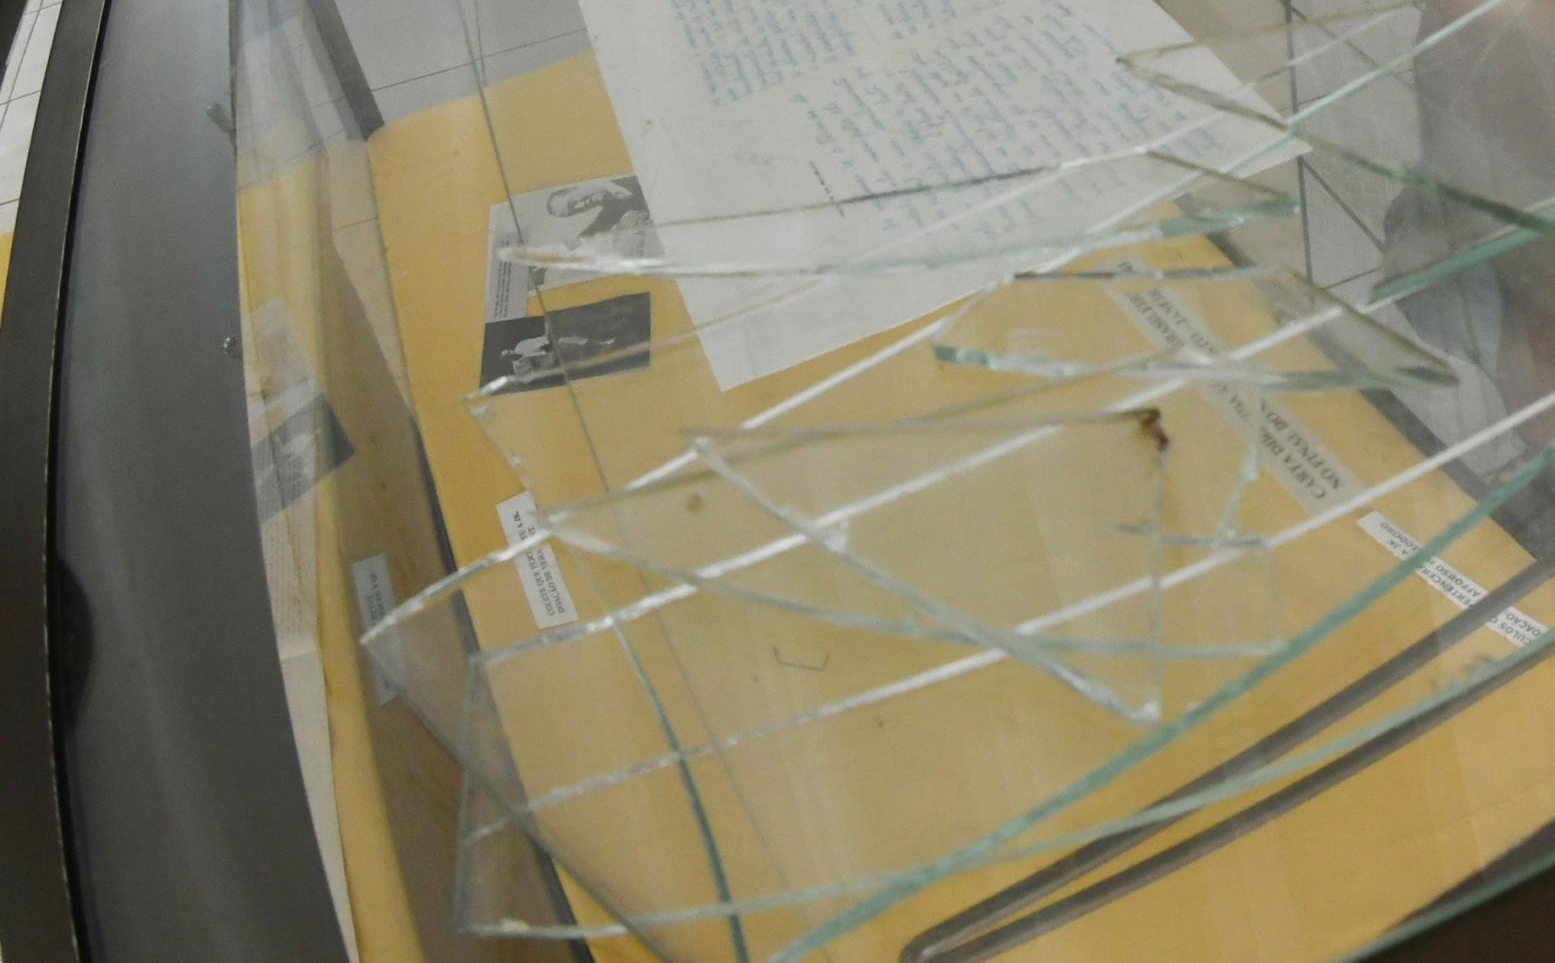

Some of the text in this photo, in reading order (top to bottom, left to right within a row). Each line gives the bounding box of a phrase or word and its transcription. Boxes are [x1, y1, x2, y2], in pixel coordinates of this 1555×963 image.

[1288, 433, 1325, 468] FINAL
[1283, 455, 1326, 498] CARTA
[1321, 468, 1342, 490] NO
[1499, 621, 1533, 646] CULOS
